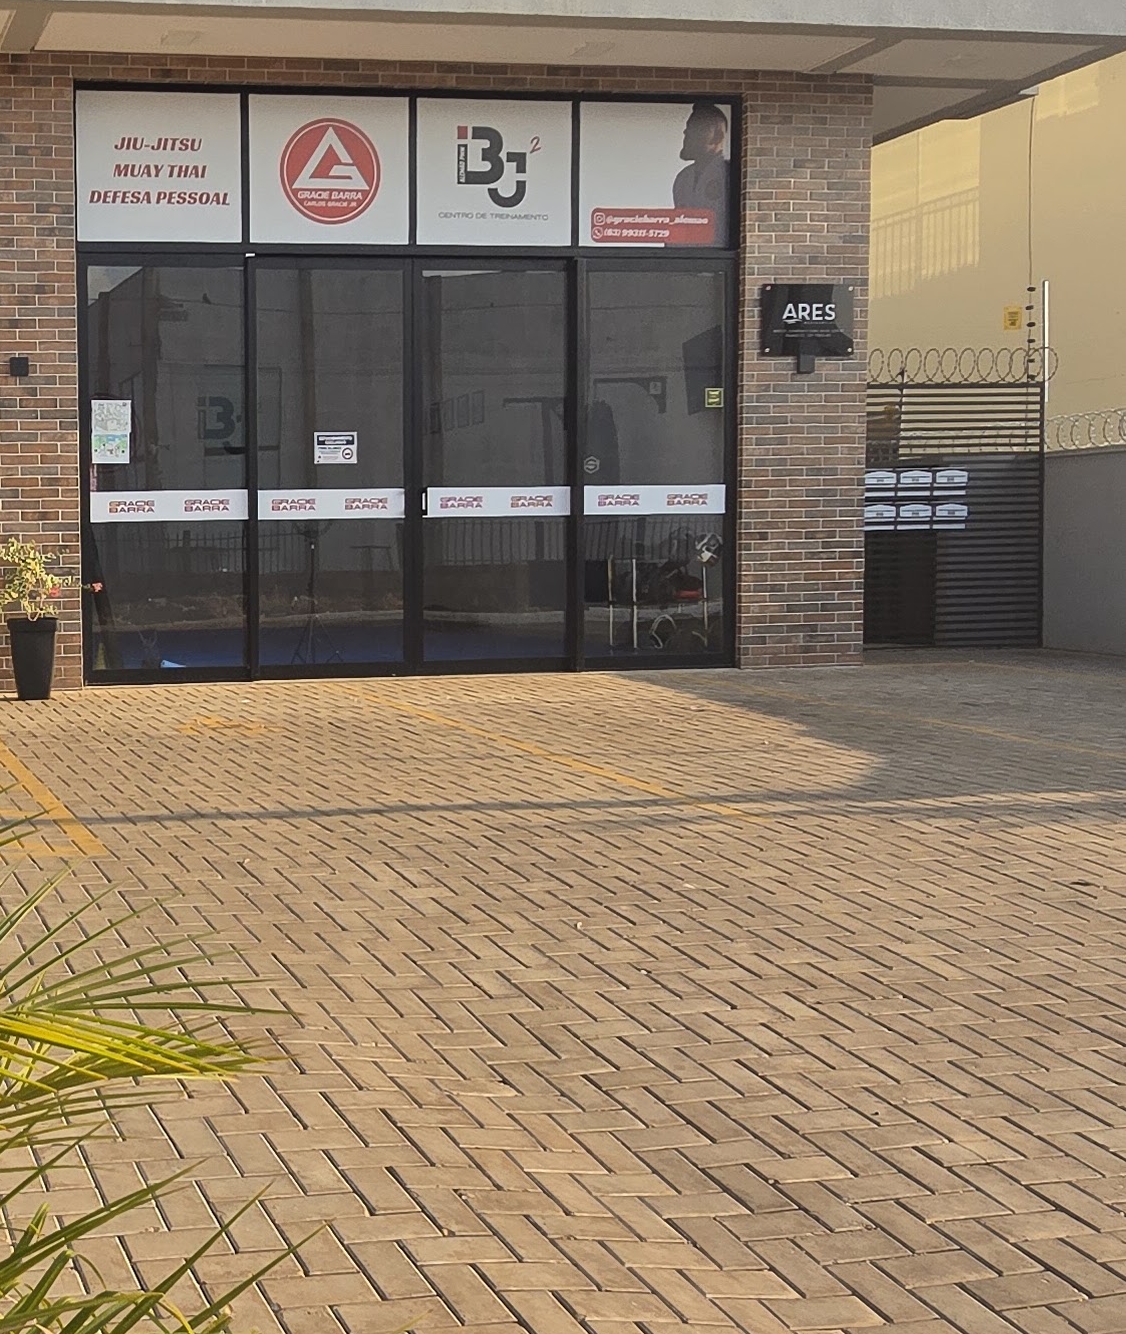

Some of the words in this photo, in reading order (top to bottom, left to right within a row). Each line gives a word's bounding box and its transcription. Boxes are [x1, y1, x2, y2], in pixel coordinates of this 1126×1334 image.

[113, 136, 202, 152] JIU-JITSU
[113, 163, 164, 178] MUAY
[167, 164, 207, 178] THAI
[88, 190, 151, 205] DEFESA
[156, 191, 230, 206] PESSOAL
[297, 191, 330, 199] GRACIE
[331, 191, 363, 200] BARRA
[438, 211, 474, 219] CENTRO
[489, 212, 549, 221] TREINAMENTO
[782, 303, 836, 321] ARES
